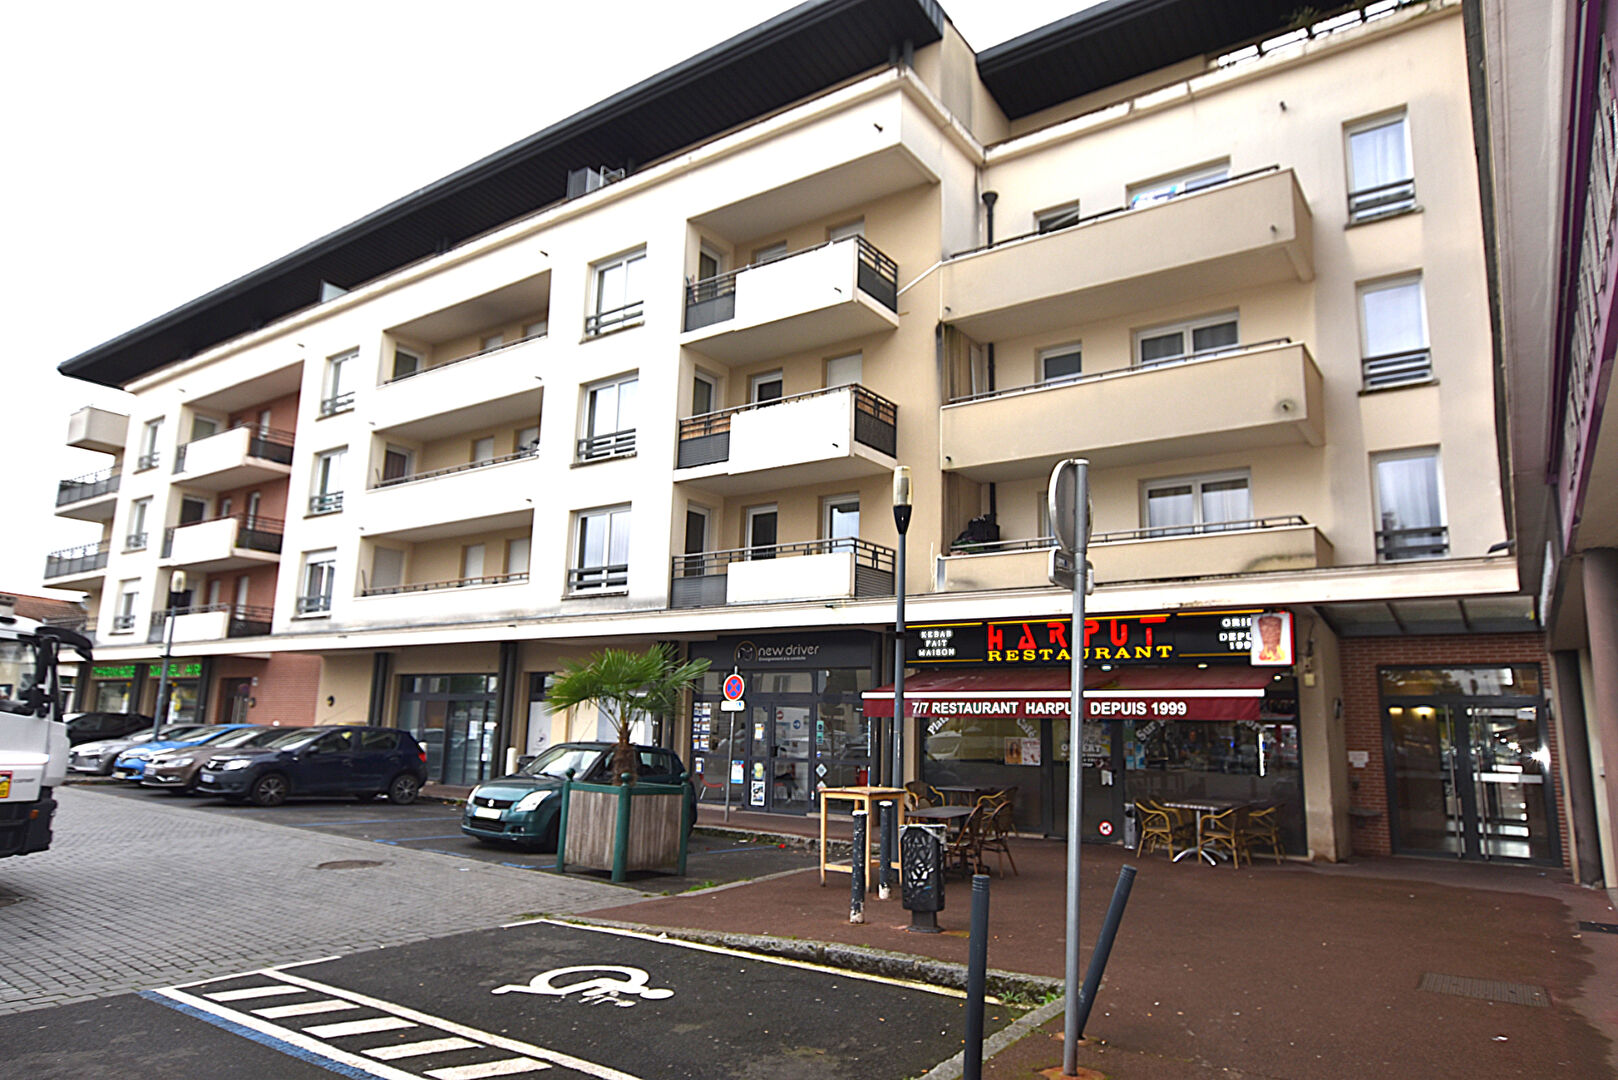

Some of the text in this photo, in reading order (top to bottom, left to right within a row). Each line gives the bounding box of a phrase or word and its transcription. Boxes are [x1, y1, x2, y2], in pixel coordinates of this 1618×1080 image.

[1222, 617, 1252, 628] GRIL
[920, 630, 953, 639] KEBAB
[988, 617, 1167, 650] HARPUT
[1219, 632, 1252, 642] DEPU
[925, 639, 948, 648] FAIT
[1229, 641, 1252, 650] 199
[758, 644, 819, 656] new driver
[918, 648, 956, 657] MAISON
[911, 702, 1187, 715] 7/7 RESTAURANT HARPU DEPUIS 1999
[1135, 721, 1156, 741] Sur
